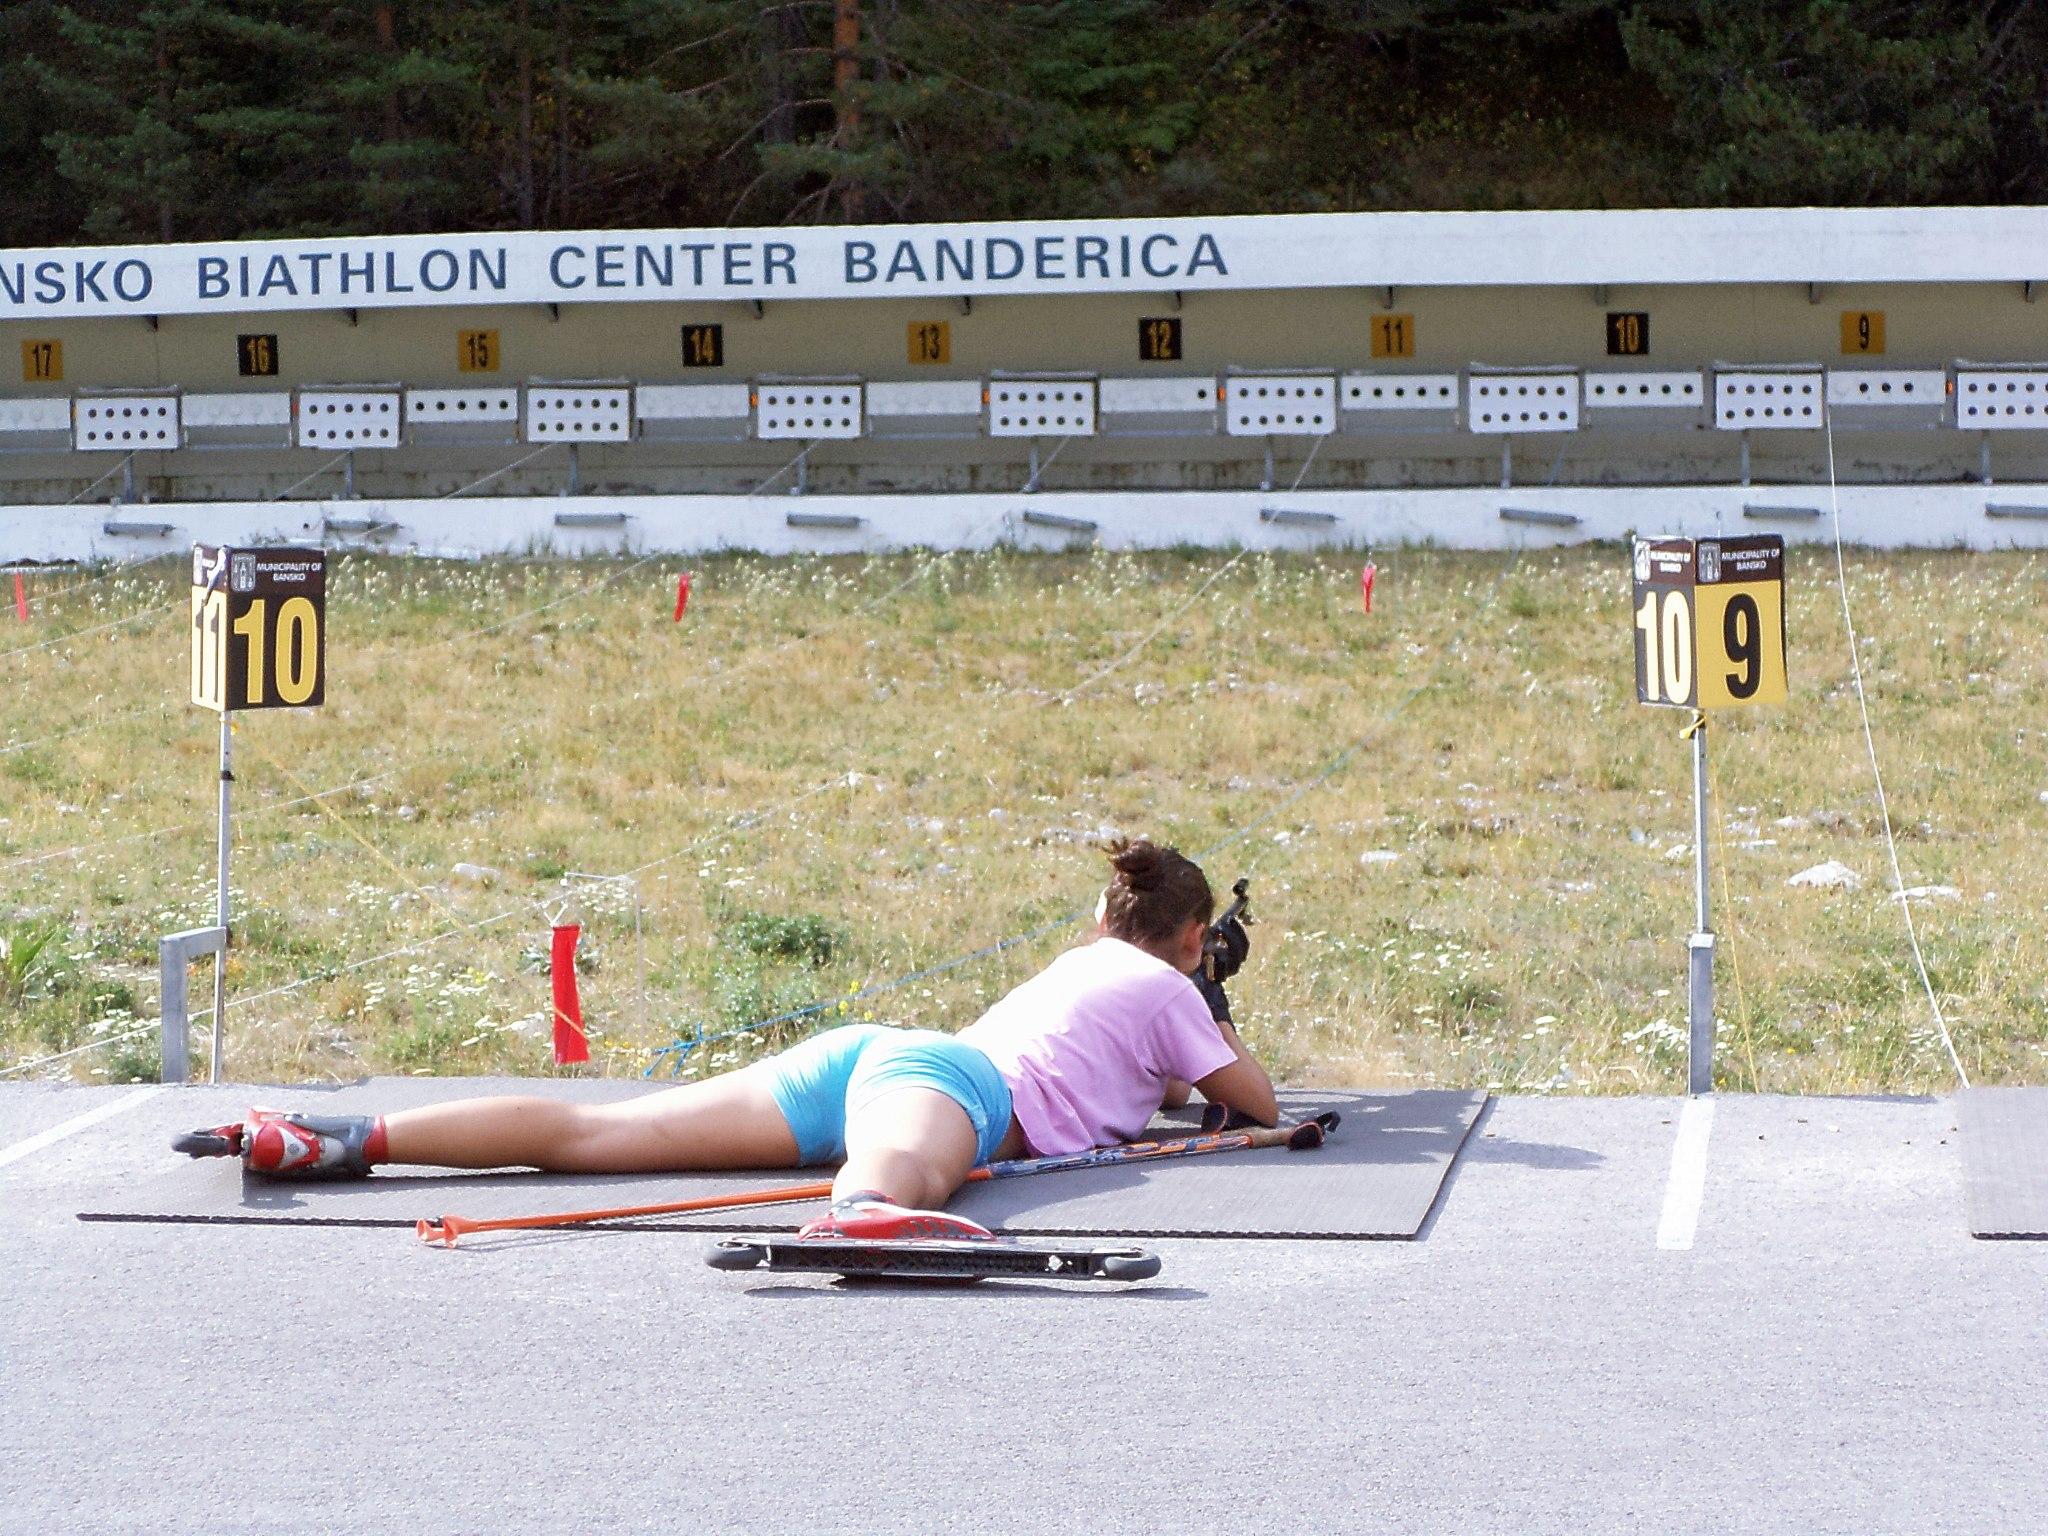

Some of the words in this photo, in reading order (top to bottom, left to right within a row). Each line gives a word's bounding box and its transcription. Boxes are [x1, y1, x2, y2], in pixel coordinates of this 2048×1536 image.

[198, 248, 507, 299] BIATHLON
[549, 243, 797, 289] CENTER
[844, 233, 1229, 283] BANDERICA
[689, 327, 714, 363] 14
[918, 324, 940, 360] 13
[1147, 321, 1172, 358] 12
[1383, 320, 1403, 353] 11
[1616, 315, 1639, 353] 10
[1859, 313, 1869, 349] 9
[32, 344, 51, 376] 17
[247, 336, 270, 374] 16
[467, 332, 489, 368] 15
[257, 563, 309, 571] MUNICIPALITY
[311, 563, 322, 571] OF
[1721, 550, 1770, 560] MUNICIPALITY
[233, 597, 317, 704] 10
[1636, 590, 1692, 704] 10
[1723, 593, 1762, 699] 9
